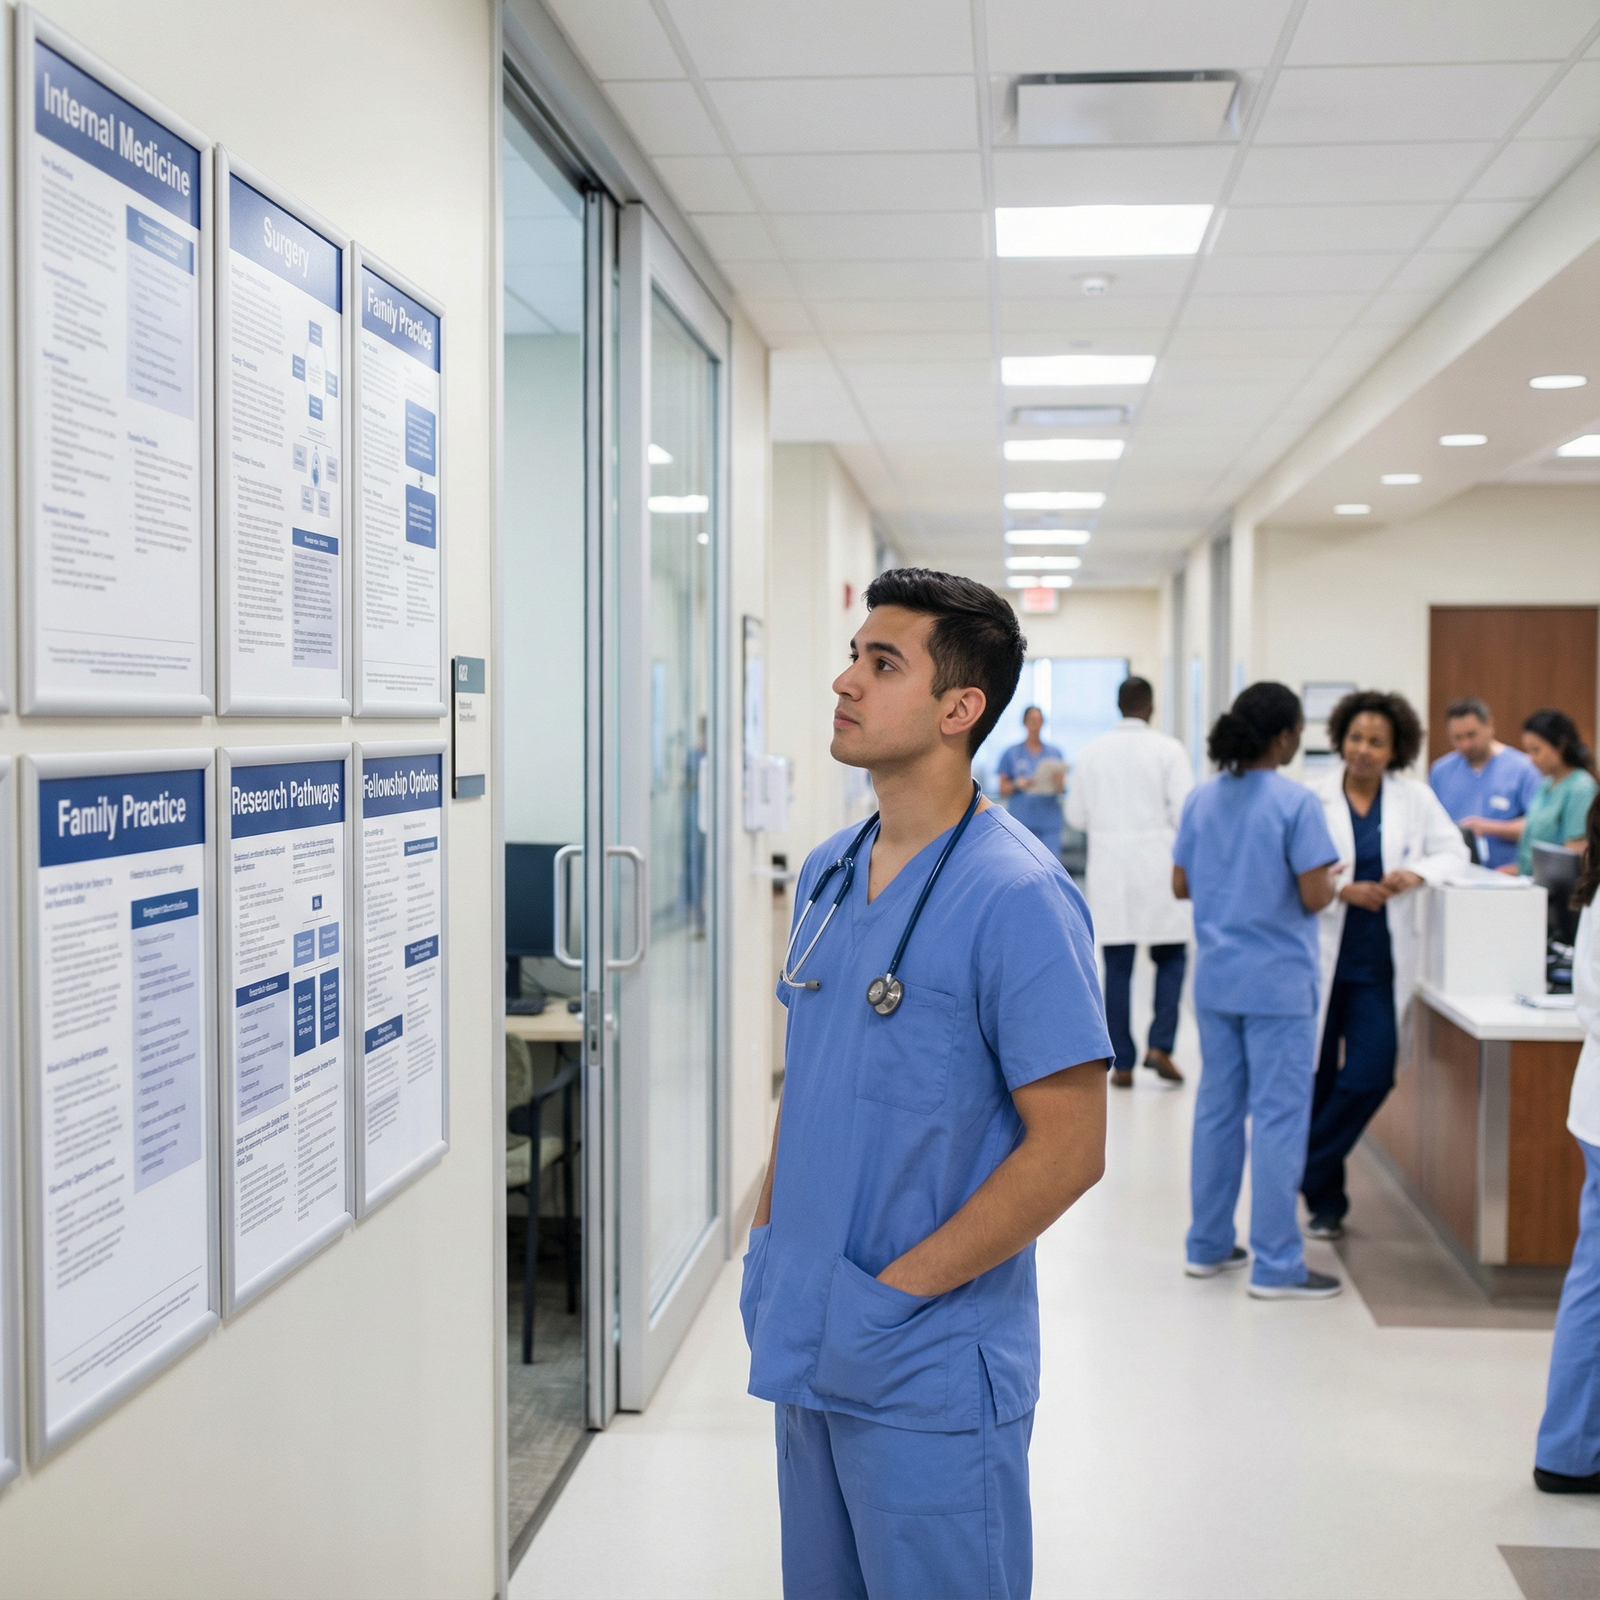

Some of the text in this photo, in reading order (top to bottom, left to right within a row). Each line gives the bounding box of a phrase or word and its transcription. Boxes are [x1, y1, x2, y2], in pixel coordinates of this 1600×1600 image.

[44, 72, 190, 196] Internal Medicine
[263, 216, 309, 278] Surgery
[367, 286, 432, 351] Family Practice
[232, 778, 339, 815] Research Pathways
[363, 768, 439, 800] Fellowship Options
[58, 791, 187, 841] Family Practice
